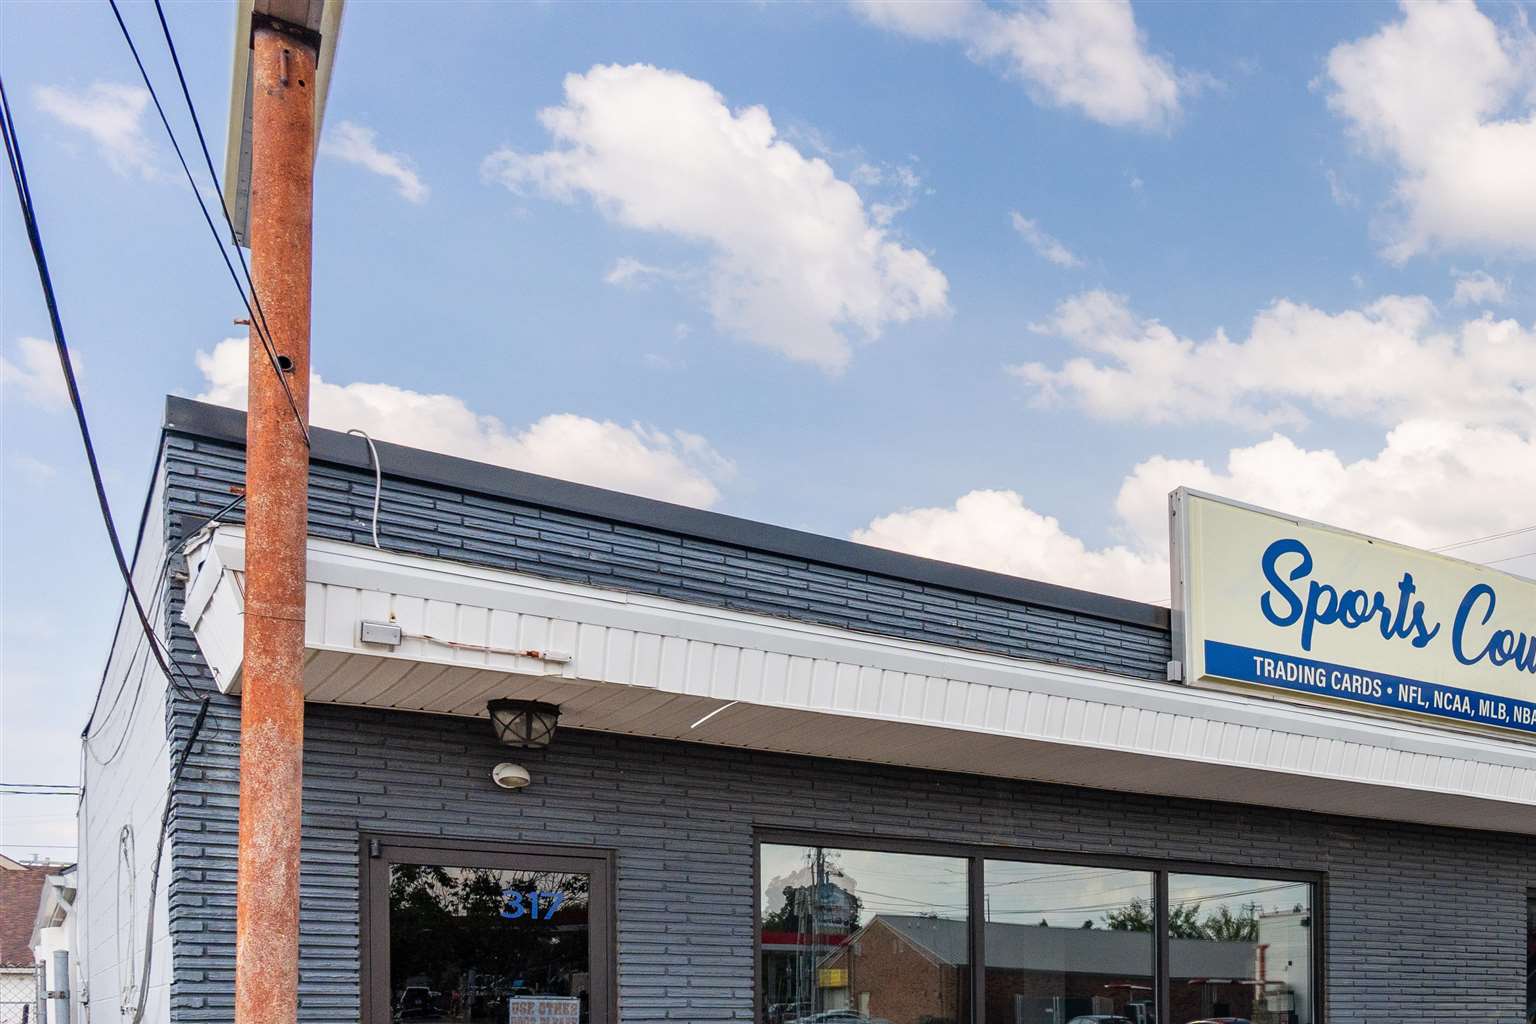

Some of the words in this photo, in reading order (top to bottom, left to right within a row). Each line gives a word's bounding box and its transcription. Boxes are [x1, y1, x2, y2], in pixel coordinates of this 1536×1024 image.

[1260, 538, 1440, 651] Sports
[1254, 656, 1327, 688] TRADING
[1331, 671, 1382, 698] CARDS
[1398, 684, 1430, 709] NFL,
[1434, 690, 1475, 717] NCAA,
[1478, 699, 1510, 723] MLB,
[500, 889, 563, 920] 317
